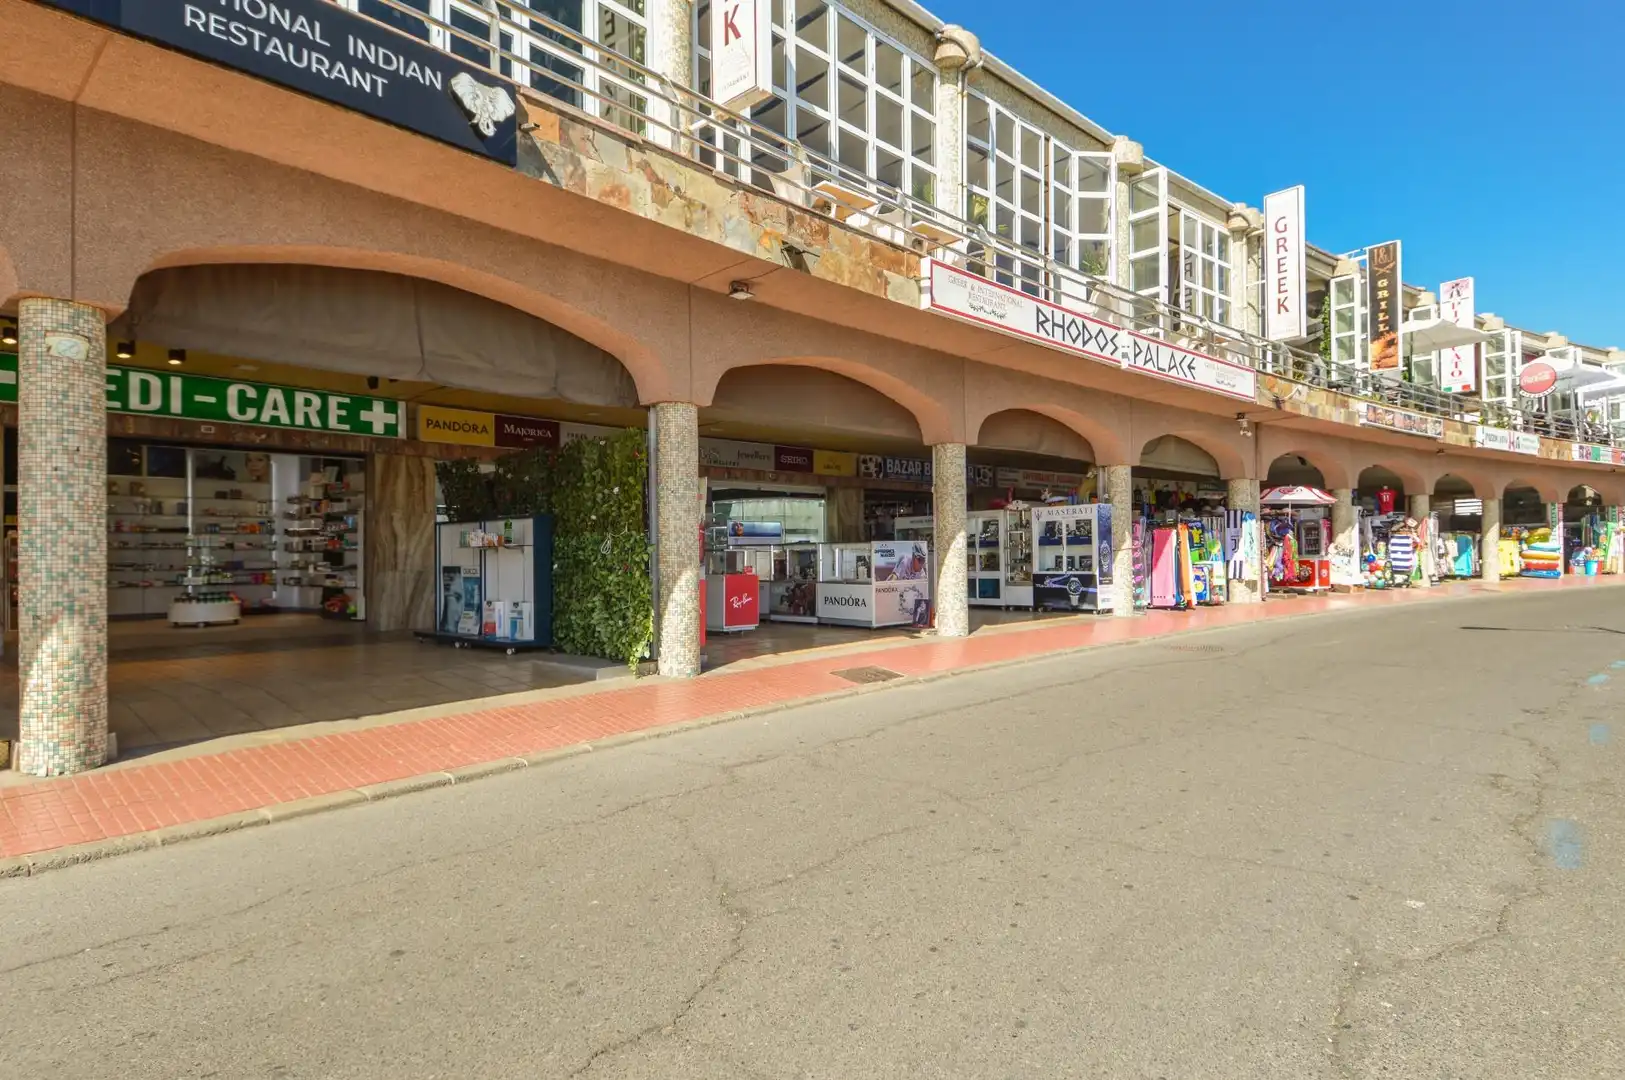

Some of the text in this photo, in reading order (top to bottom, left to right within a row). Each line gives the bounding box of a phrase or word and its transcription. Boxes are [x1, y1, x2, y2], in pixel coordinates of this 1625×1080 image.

[184, 4, 389, 98] RESTAURANT
[348, 35, 442, 91] INDIAN
[1274, 216, 1289, 314] GREEK
[1377, 279, 1389, 332] GRILL
[1036, 305, 1196, 380] RHODOS PALACE
[107, 369, 352, 432] EDI-CARE
[426, 418, 489, 434] PANDORA
[886, 459, 922, 475] BAZAR
[1047, 508, 1093, 516] MASERATI
[824, 595, 867, 608] PANDORA
